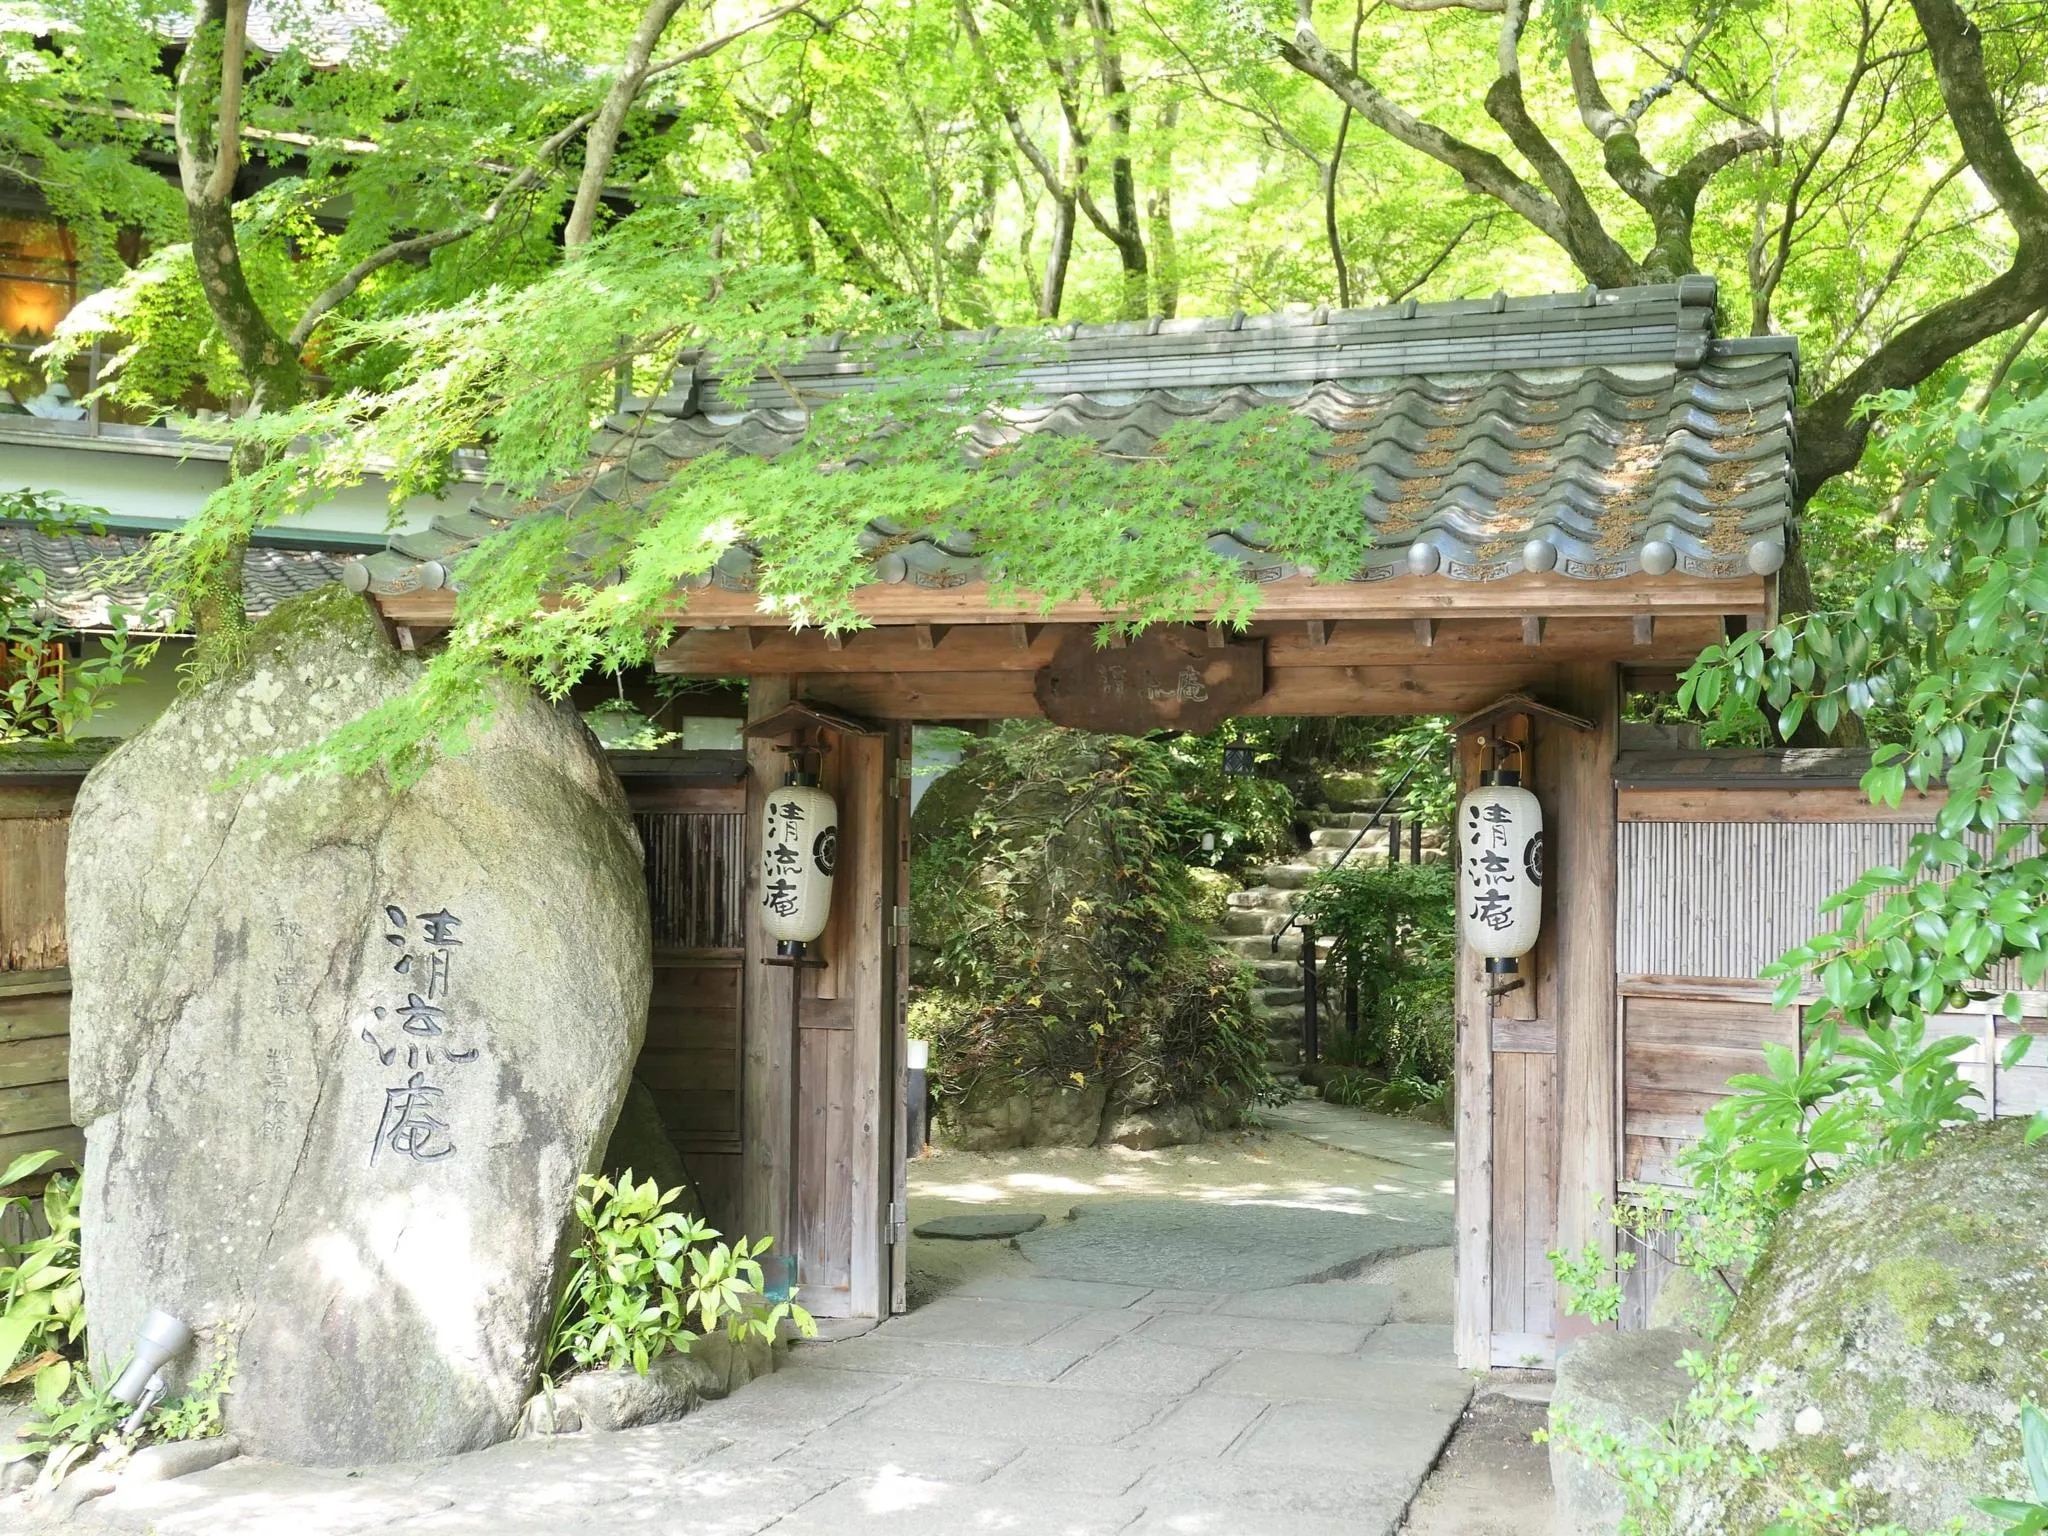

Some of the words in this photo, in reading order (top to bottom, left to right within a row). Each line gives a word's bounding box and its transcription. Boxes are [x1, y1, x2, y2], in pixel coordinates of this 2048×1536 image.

[763, 801, 804, 917] 清流庵
[1468, 803, 1515, 931] 清流庵
[361, 904, 479, 1168] 清流庵
